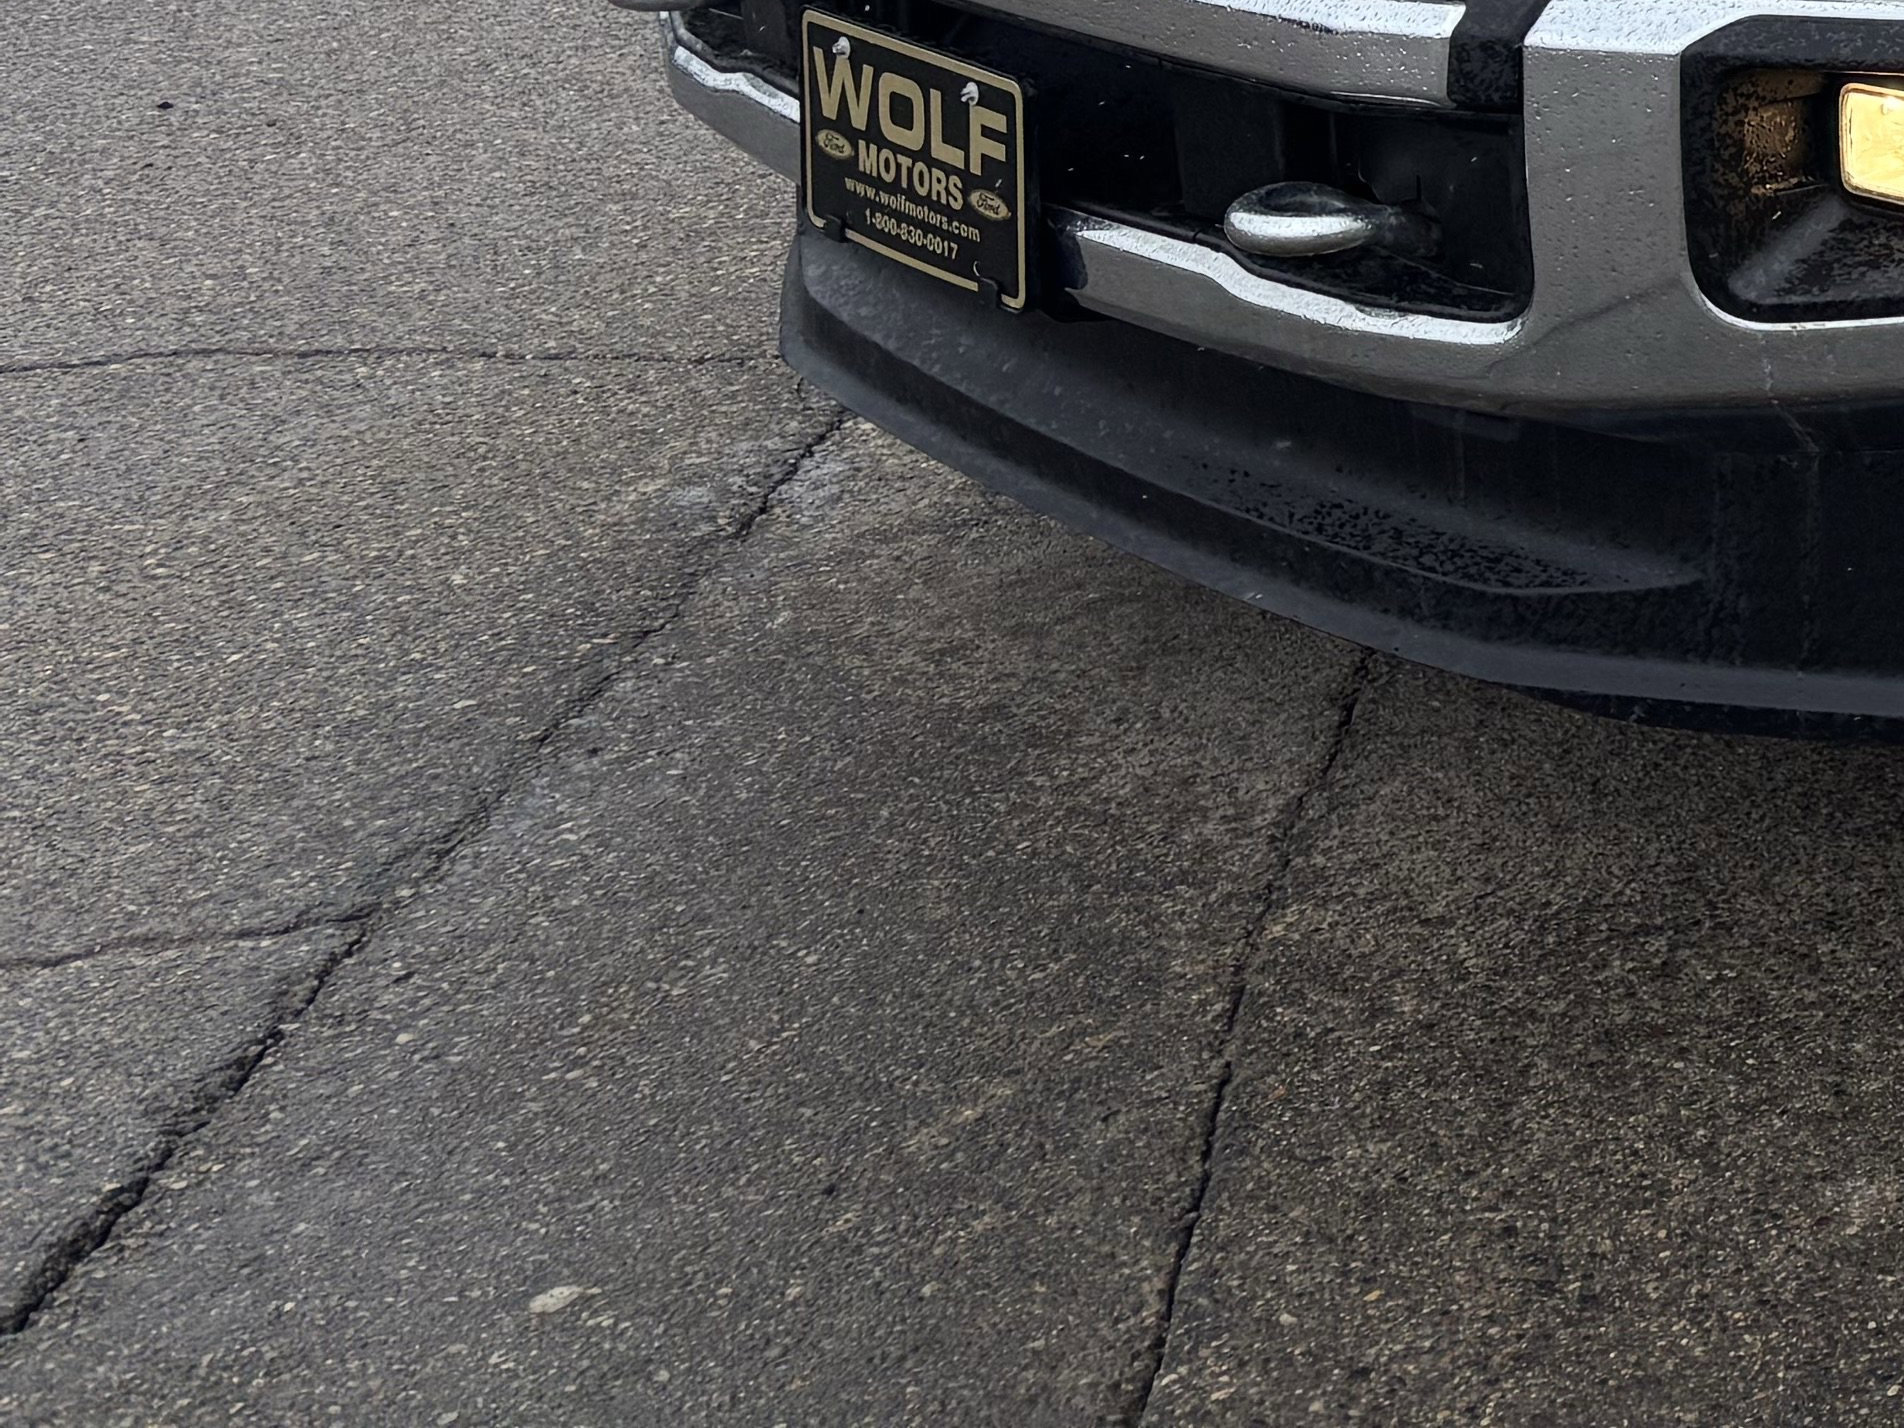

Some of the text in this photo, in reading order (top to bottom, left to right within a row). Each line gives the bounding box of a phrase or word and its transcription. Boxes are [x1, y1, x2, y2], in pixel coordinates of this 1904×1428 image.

[813, 46, 1008, 176] WOLF
[858, 139, 964, 210] MOTORS
[845, 178, 981, 243] www.wolfmotors.com
[865, 209, 959, 260] 1-800-830-0017
